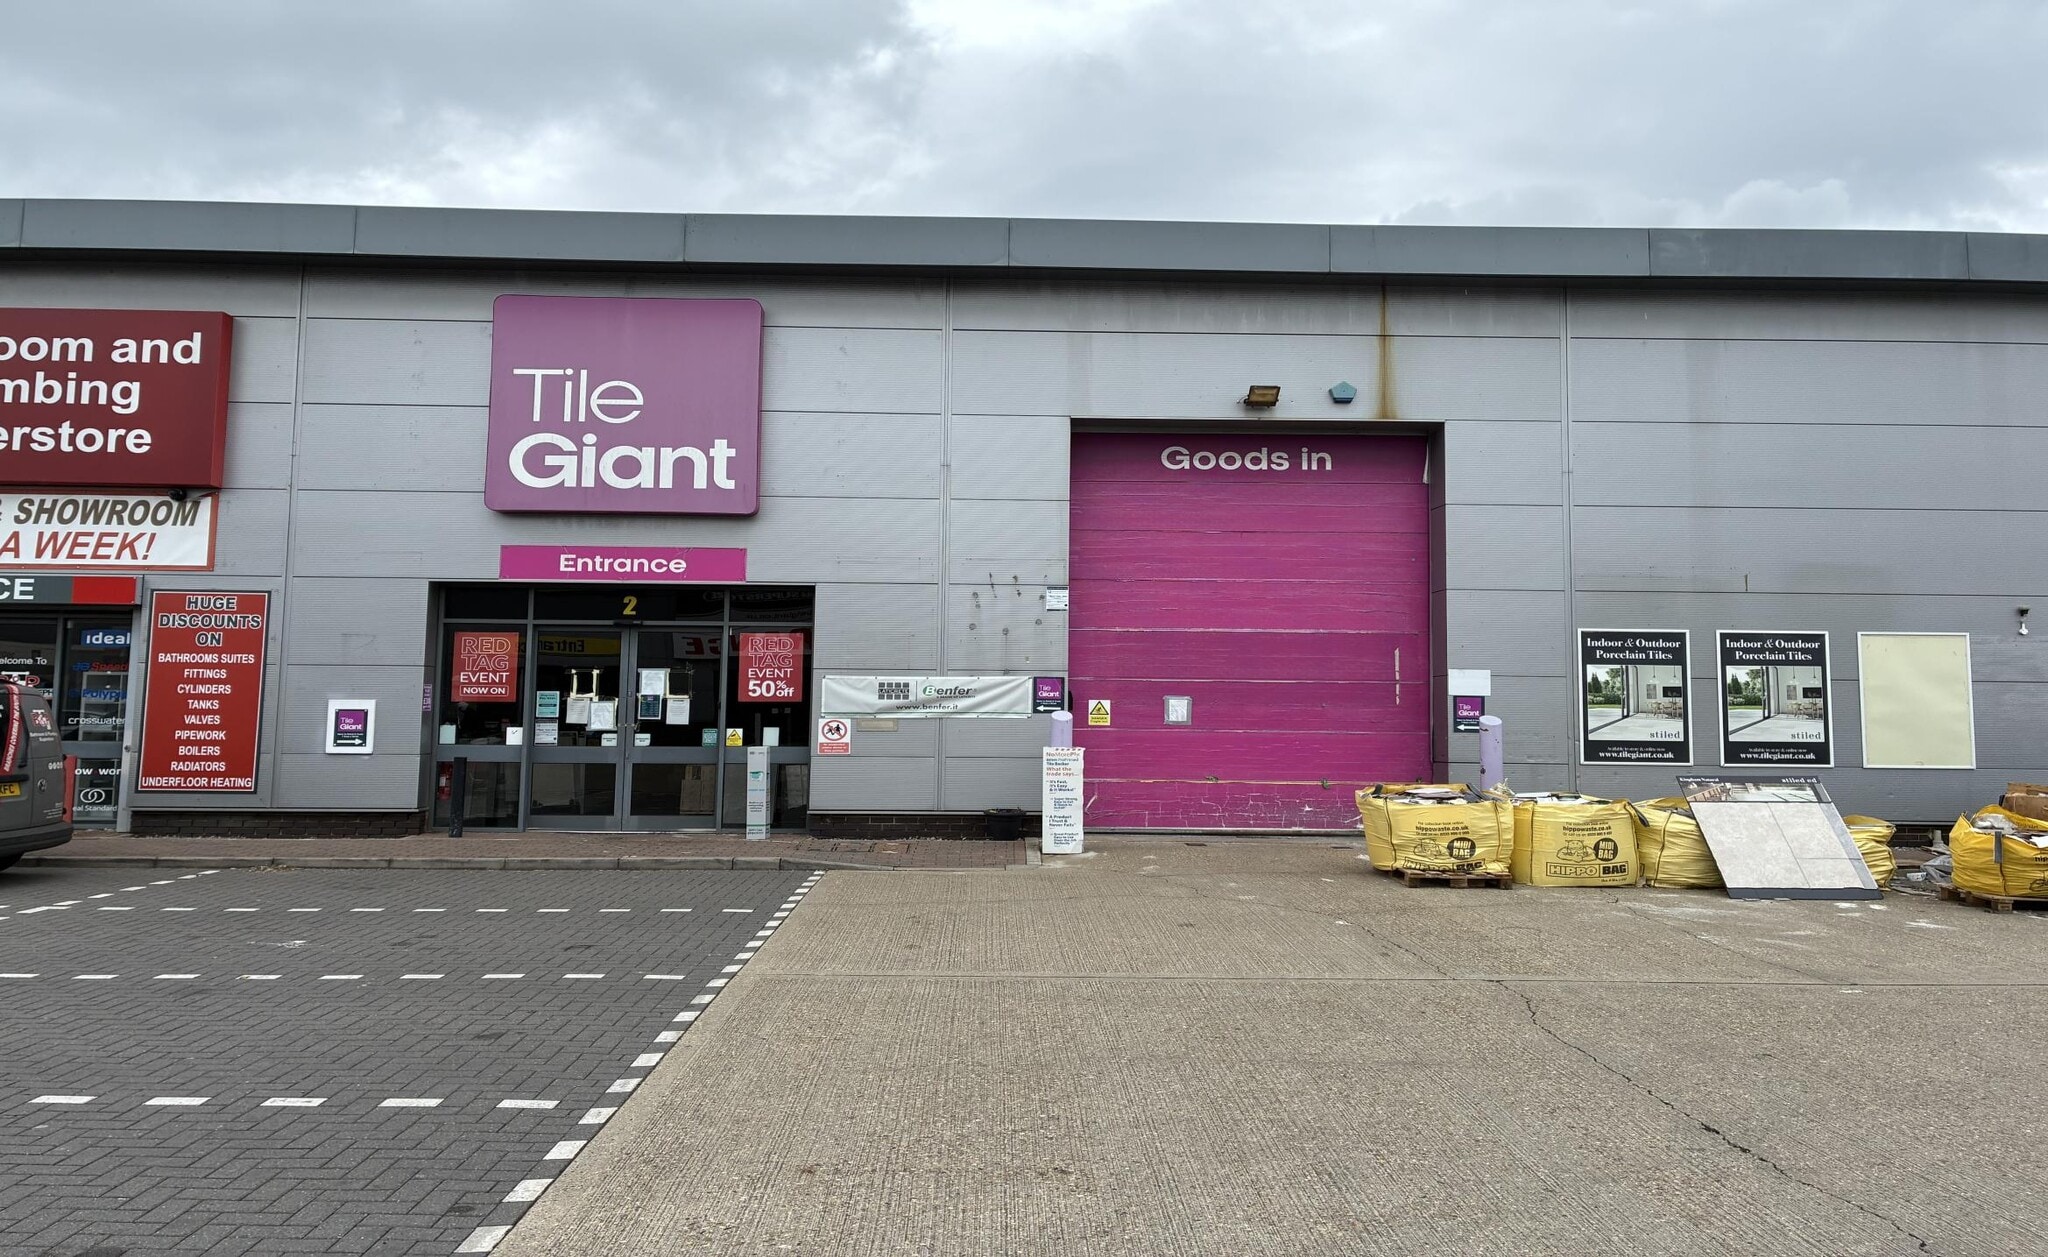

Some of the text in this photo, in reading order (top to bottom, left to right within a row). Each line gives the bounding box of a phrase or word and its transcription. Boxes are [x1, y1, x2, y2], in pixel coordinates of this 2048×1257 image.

[111, 332, 202, 364] and
[513, 368, 644, 424] Tile
[509, 432, 736, 490] Giant
[1161, 446, 1332, 471] Goods in
[14, 498, 201, 526] SHOWROOM
[0, 531, 156, 560] A WEEK!
[559, 554, 687, 573] Entrance
[185, 596, 237, 611] HUGE
[623, 596, 637, 615] 2
[158, 613, 261, 629] DISCOUNTS
[195, 632, 223, 646] ON
[1587, 638, 1681, 648] Indoor & Outdoor
[1725, 639, 1820, 649] Indoor & Outdoor
[461, 637, 511, 654] RED
[748, 637, 794, 652] RED
[158, 653, 255, 664] BATHROOMS SUITES
[749, 652, 793, 667] TAG
[1596, 650, 1673, 660] Porcelain Tiles
[1735, 651, 1812, 661] Porcelain Tiles
[461, 654, 509, 671] TAG
[184, 669, 227, 679] FITTINGS
[460, 672, 510, 683] EVENT
[748, 668, 793, 678] EVENT
[177, 684, 232, 694] CYLINDERS
[776, 687, 795, 697] off
[923, 685, 973, 696] Benfer
[187, 700, 220, 709] TANKS
[184, 715, 221, 724] VALVES
[175, 730, 226, 740] PIPEWORK
[1649, 730, 1680, 739] stiled
[1791, 731, 1821, 740] stiled
[178, 746, 221, 755] BOILERS
[1599, 751, 1674, 759] www.tilegiant.co.uk
[1740, 752, 1816, 760] www.tilegiant.co.uk
[170, 761, 226, 771] RADIATORS
[142, 777, 252, 787] UNDERFLOOR HEATING
[1453, 840, 1471, 849] MIDI
[1599, 841, 1614, 850] MIDI
[1452, 849, 1470, 858] BAG
[1598, 850, 1613, 859] BAG
[1550, 864, 1626, 876] HIPPO BAG
